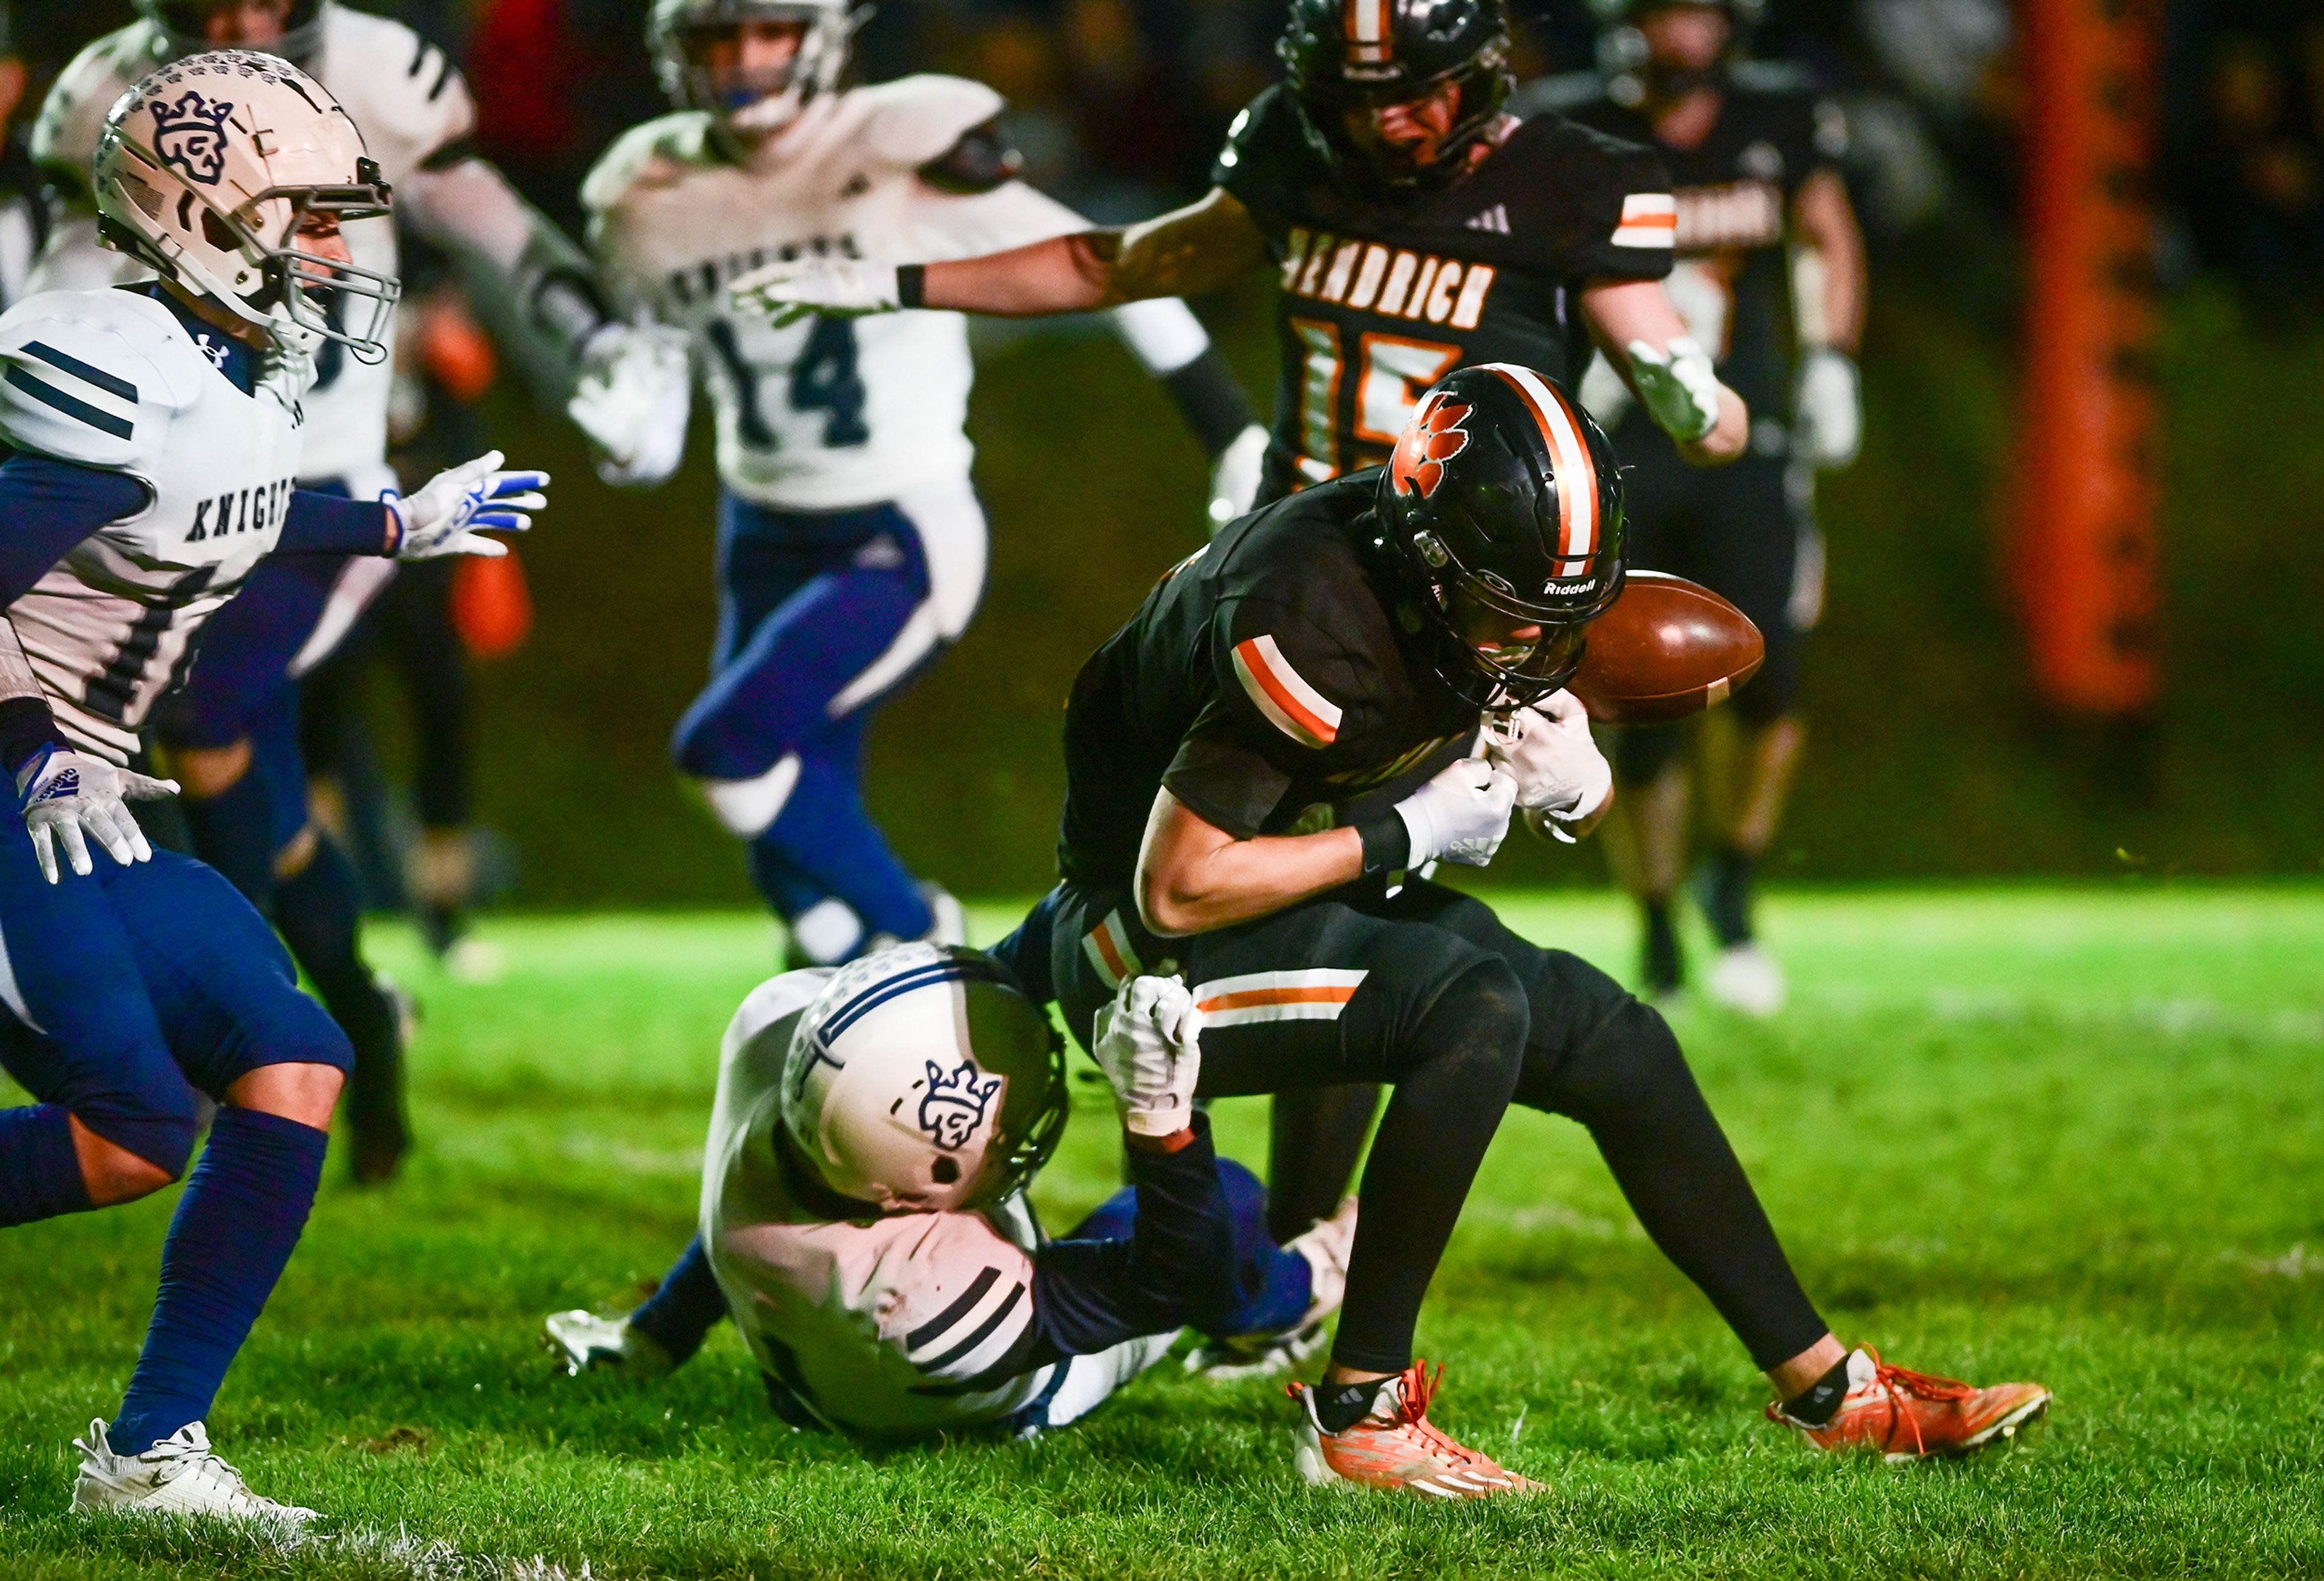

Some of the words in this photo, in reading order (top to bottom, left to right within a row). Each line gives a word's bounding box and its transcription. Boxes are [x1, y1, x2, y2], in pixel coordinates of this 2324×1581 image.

[705, 310, 870, 453] 14
[183, 476, 297, 542] KNIGHT
[1543, 578, 1597, 595] Riddell
